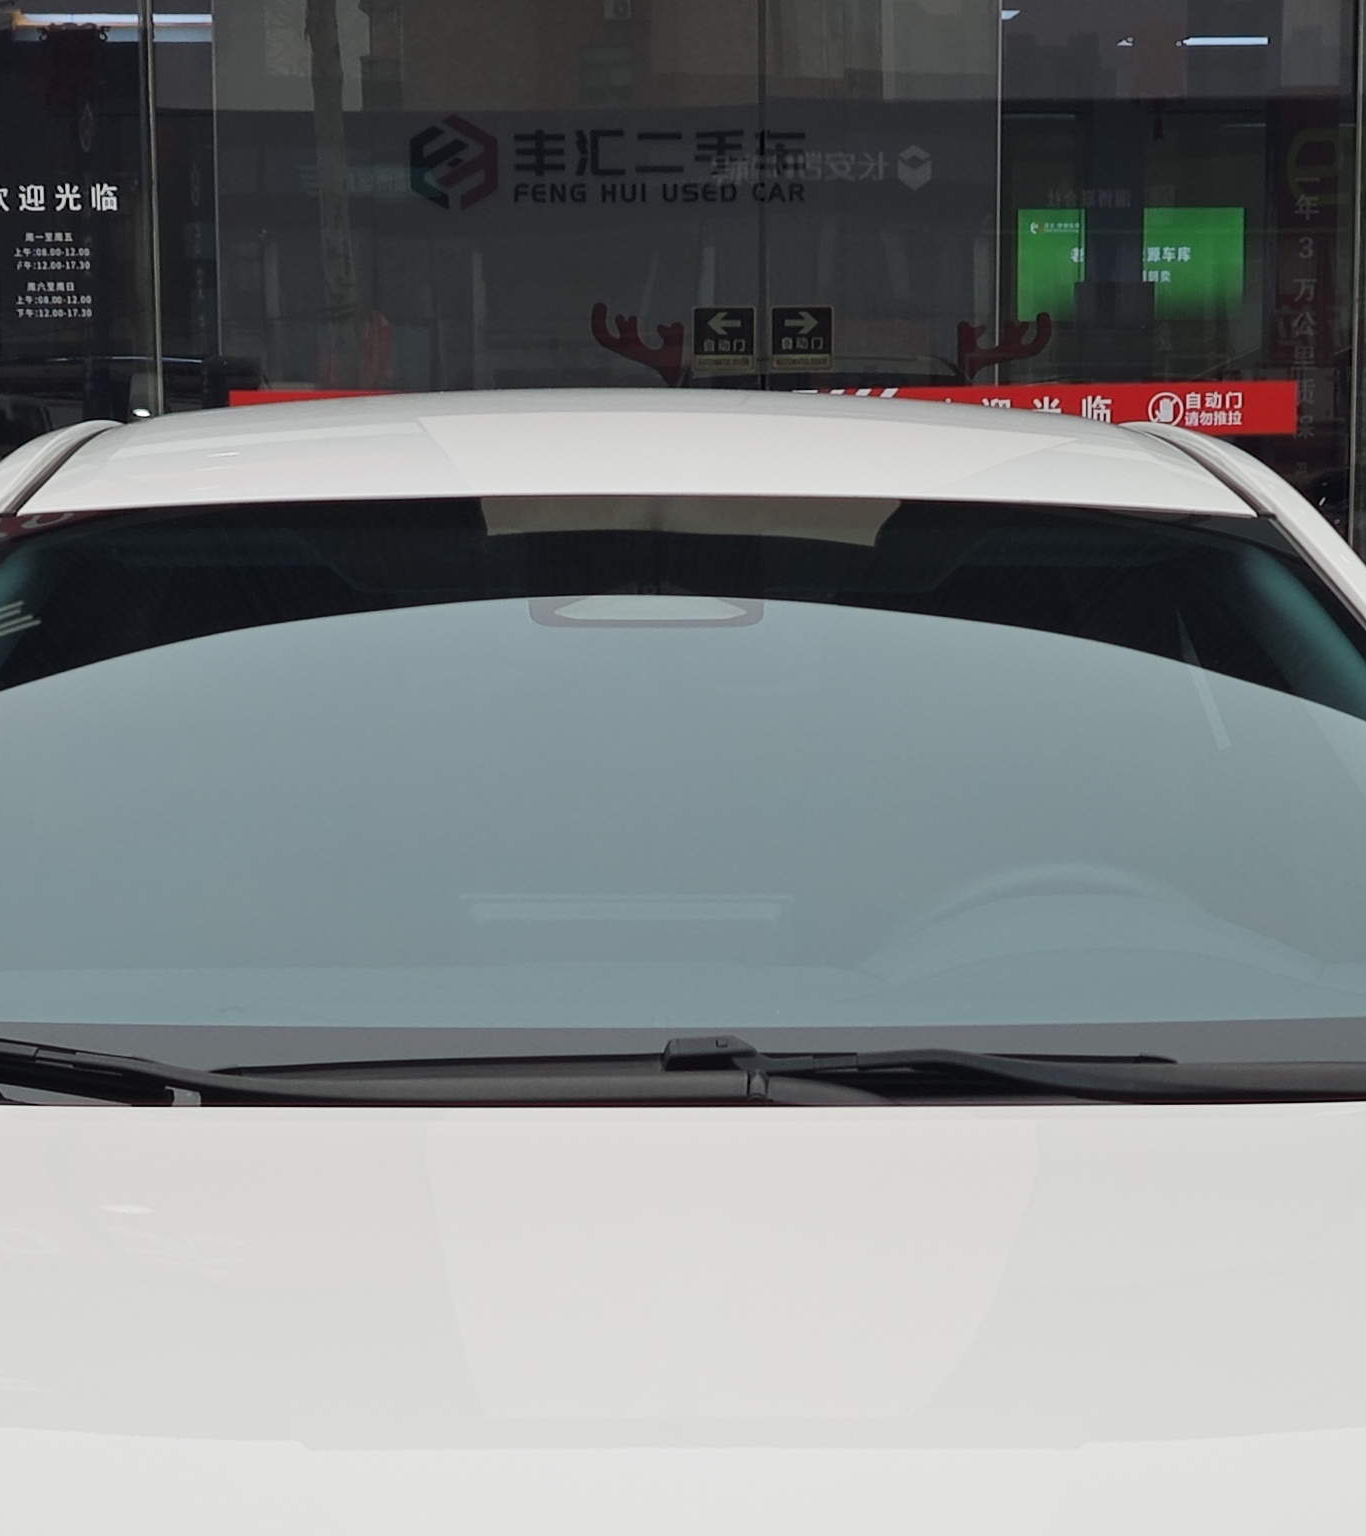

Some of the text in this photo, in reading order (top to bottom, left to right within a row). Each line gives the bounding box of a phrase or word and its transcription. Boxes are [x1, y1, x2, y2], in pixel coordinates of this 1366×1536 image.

[514, 129, 806, 176] 丰汇二手车
[514, 182, 806, 203] FENG HUI USED CAR
[25, 232, 73, 242] 周一至周五
[27, 282, 75, 292] 周六至周日
[703, 339, 746, 352] 自动门
[781, 337, 824, 350] 自动门
[1185, 391, 1243, 410] 自动门
[1184, 410, 1243, 427] 请勿推拉
